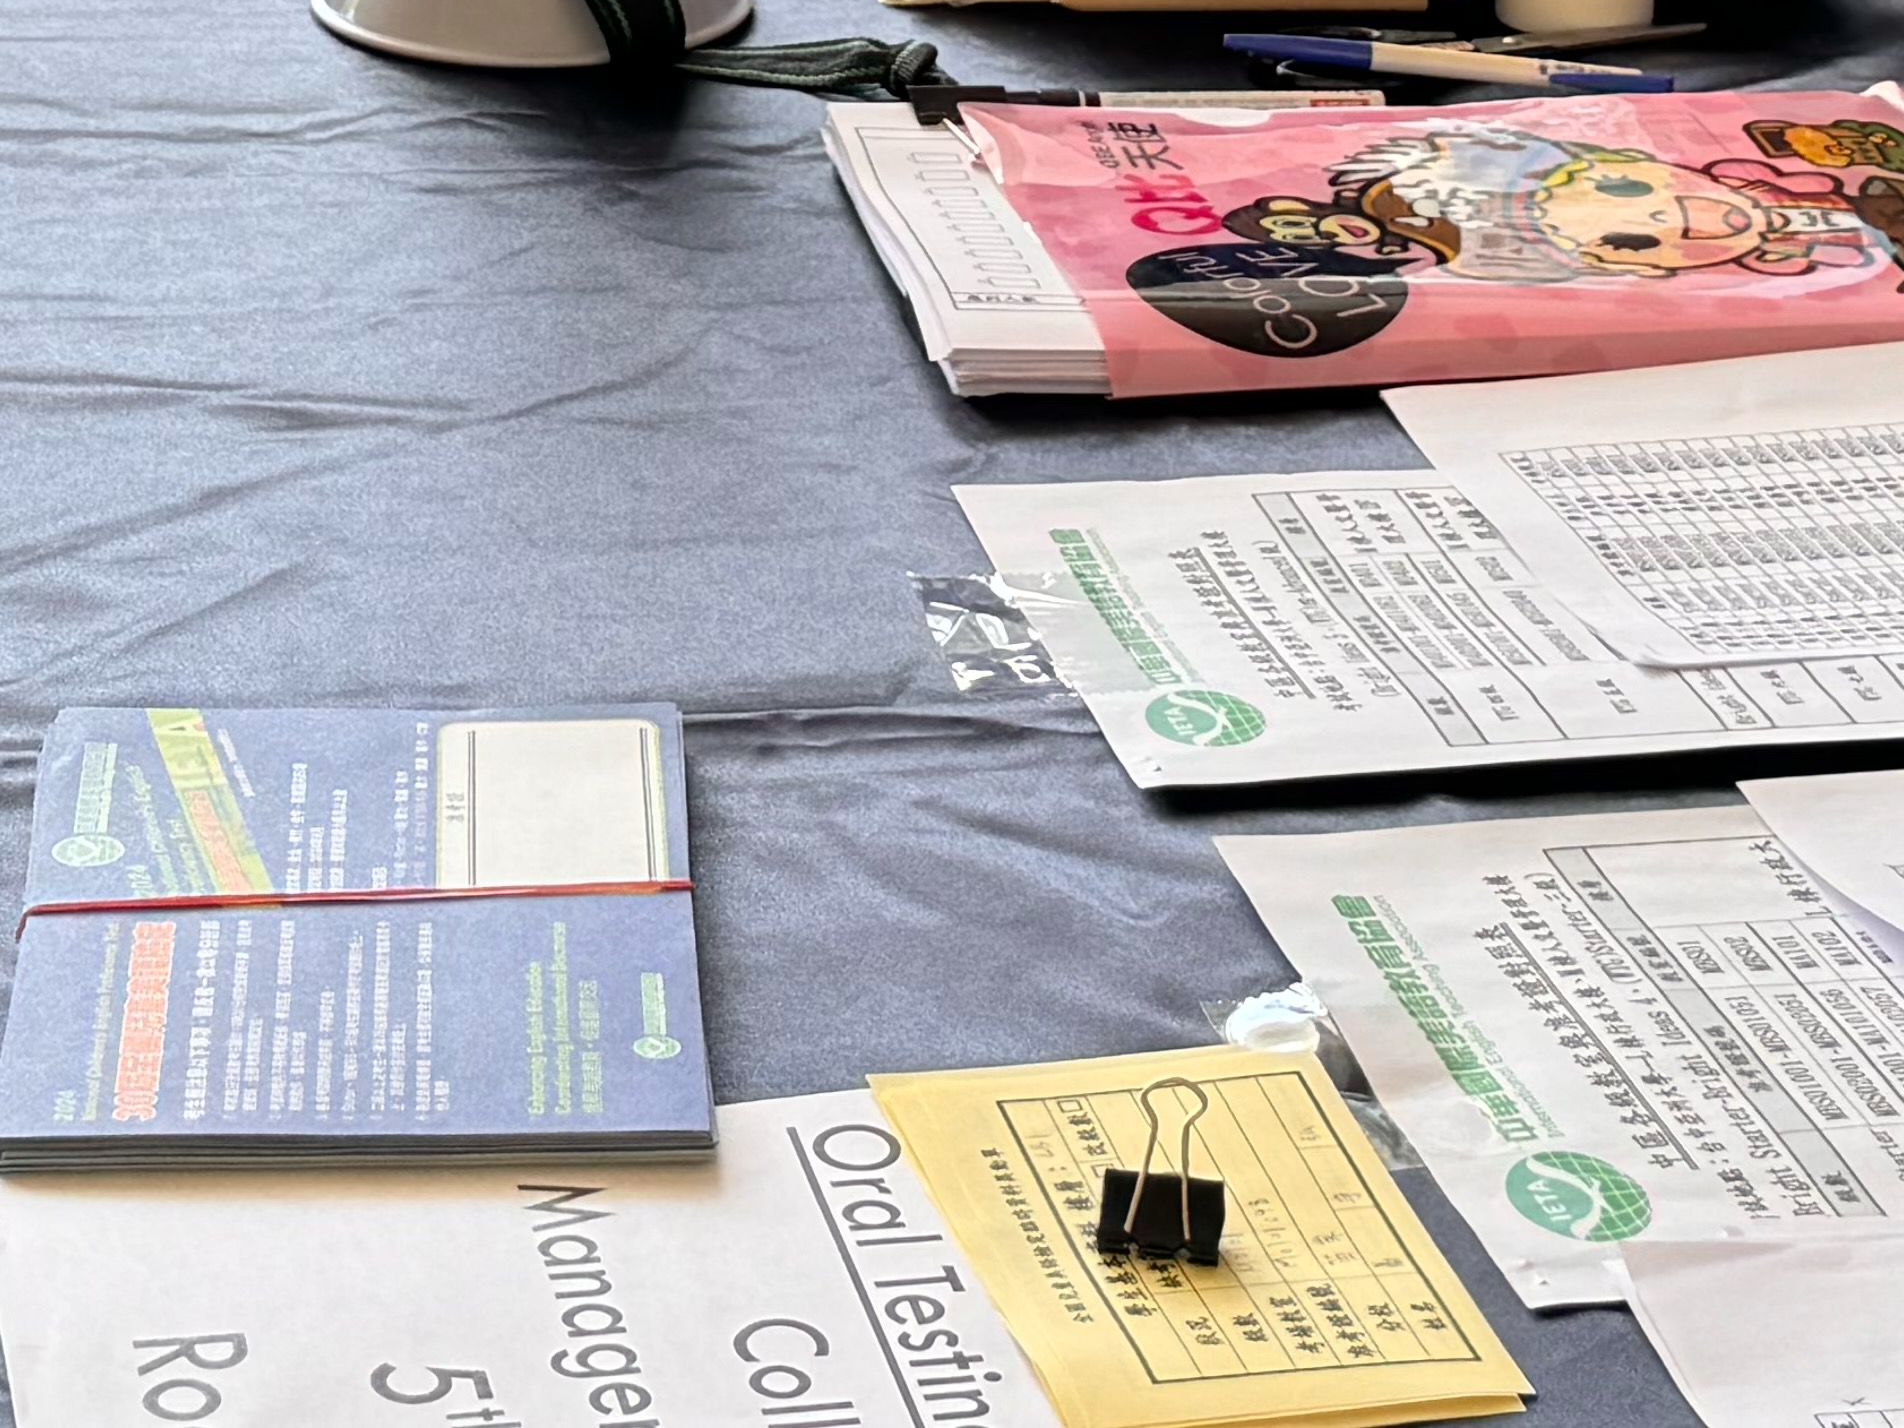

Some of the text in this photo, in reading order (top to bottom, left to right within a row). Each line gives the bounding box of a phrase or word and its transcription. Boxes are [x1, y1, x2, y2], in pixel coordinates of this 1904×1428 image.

[1101, 119, 1186, 172] 天使
[1153, 249, 1330, 349] Colorful
[1233, 246, 1395, 317] LOVE
[810, 1123, 906, 1248] Oral
